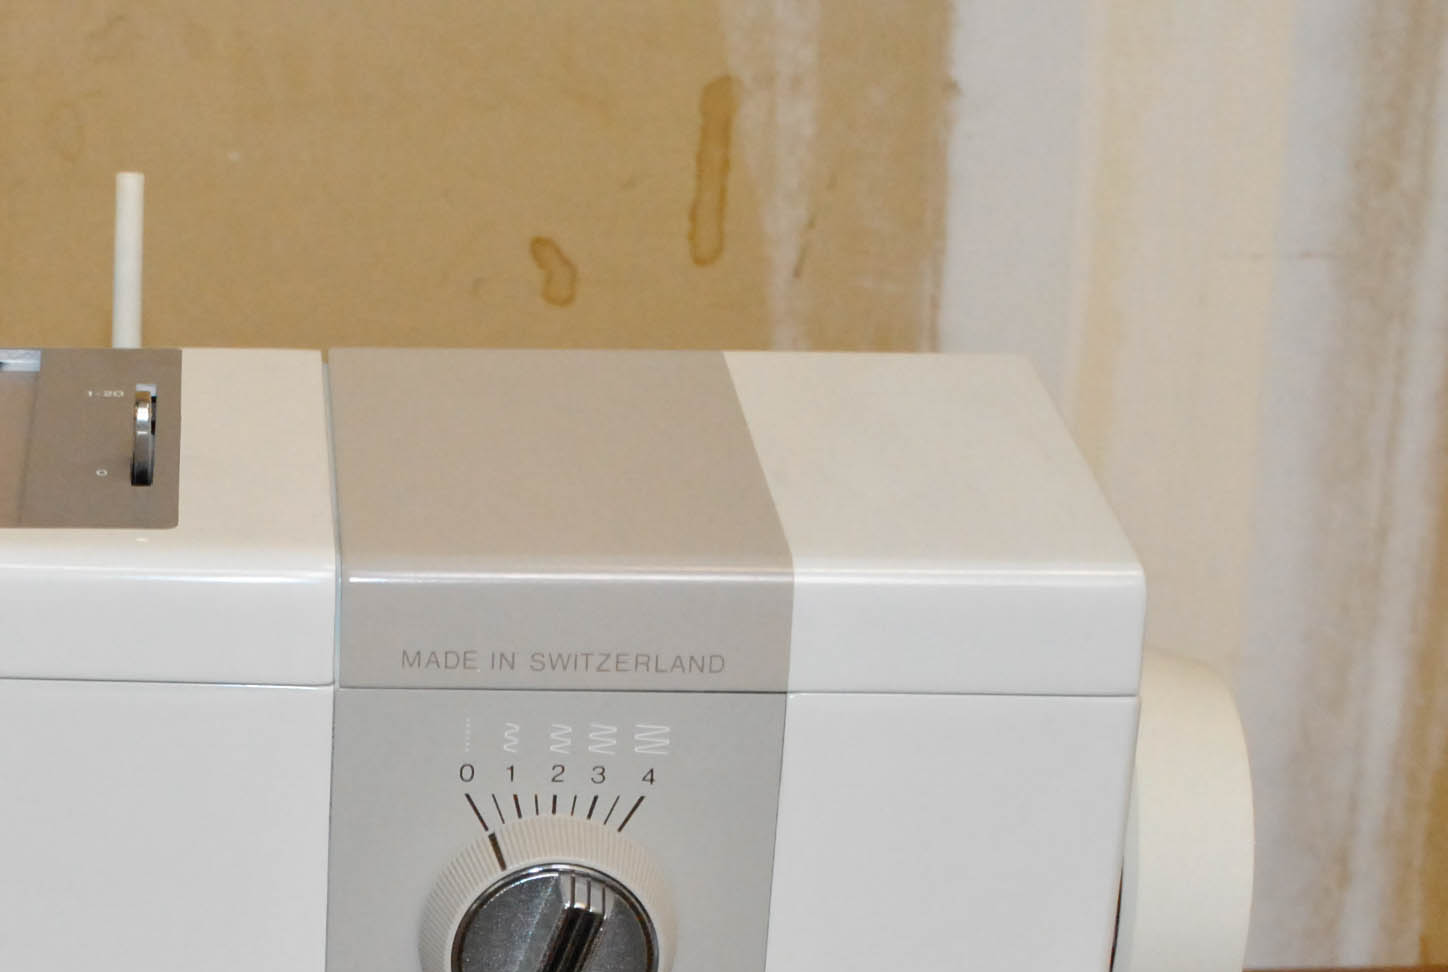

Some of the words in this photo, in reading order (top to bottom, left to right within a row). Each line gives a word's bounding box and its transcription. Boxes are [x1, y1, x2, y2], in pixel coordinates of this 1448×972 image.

[400, 650, 479, 671] MADE
[490, 652, 517, 671] IN
[529, 651, 727, 674] SWITZERLAND
[459, 763, 475, 783] 0
[505, 764, 516, 782] 1
[551, 763, 566, 783] 2
[590, 764, 607, 785] 3
[641, 767, 657, 785] 4
